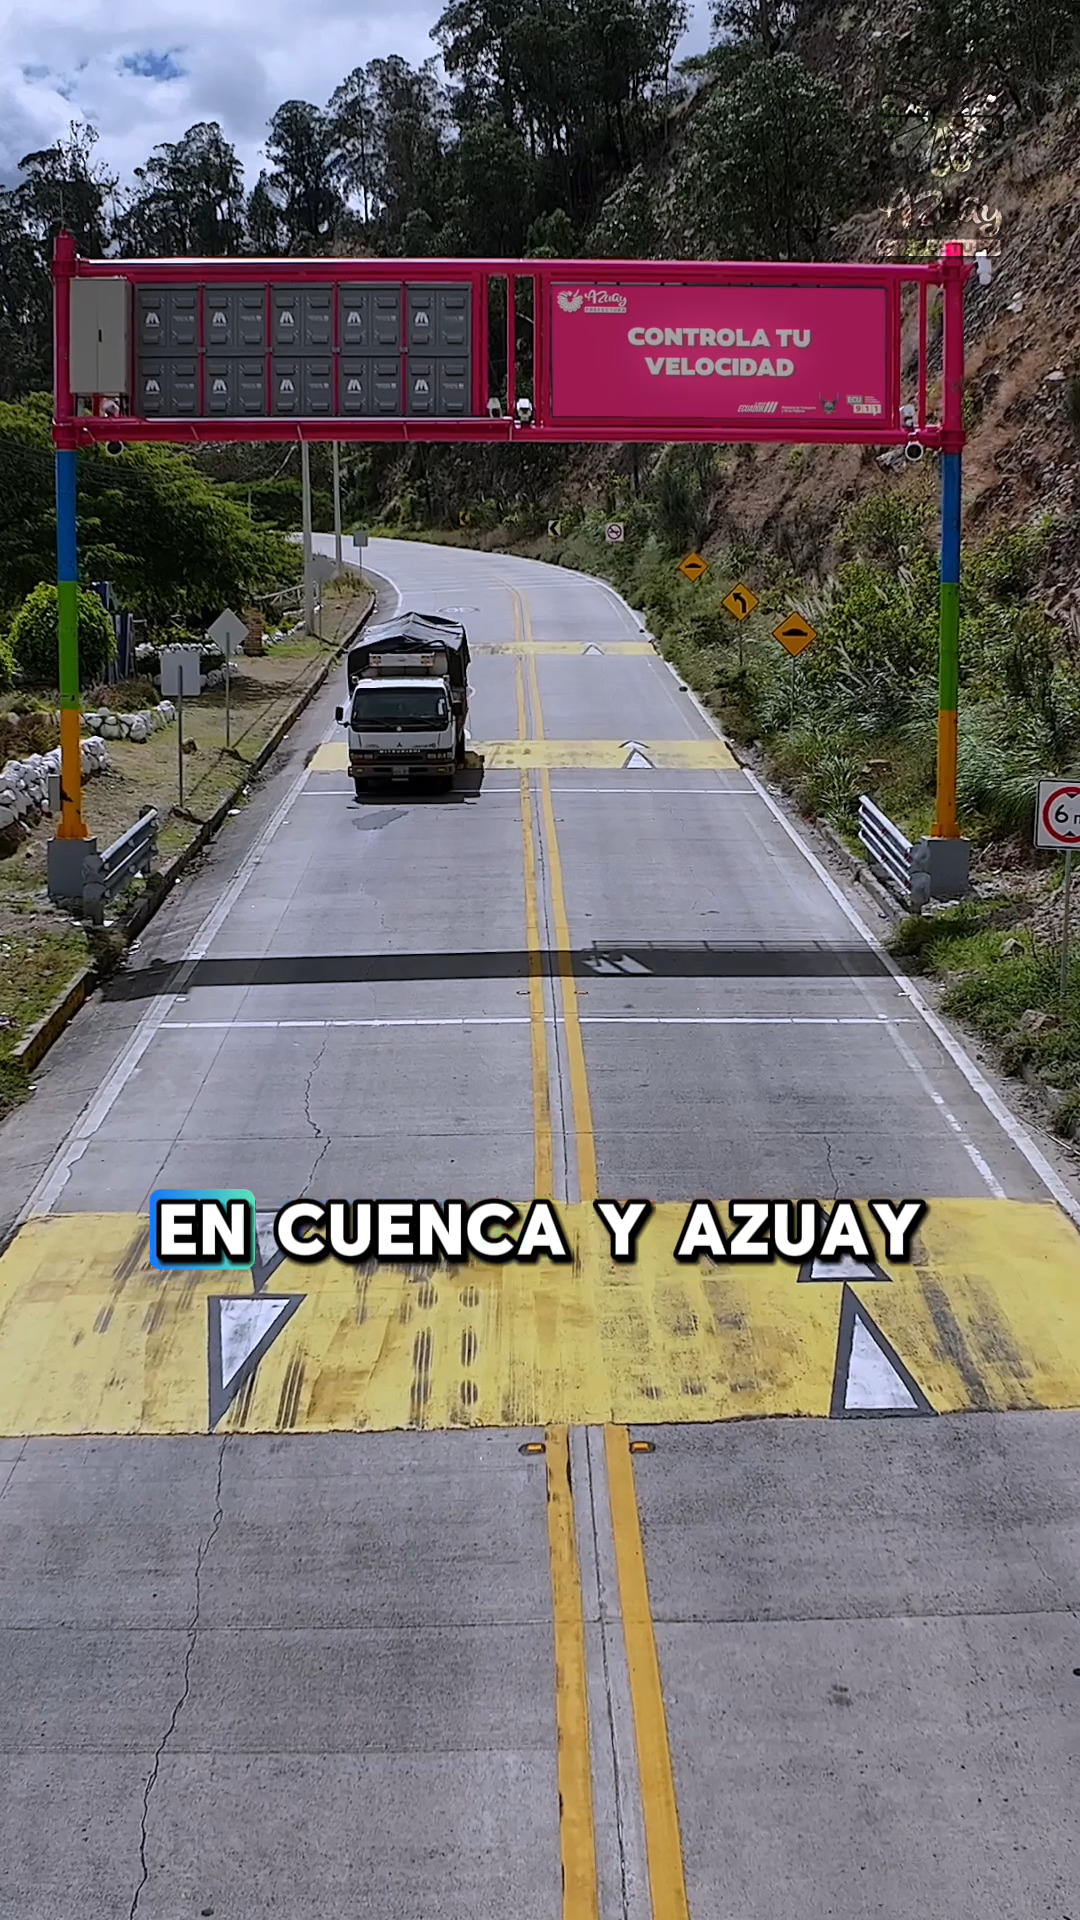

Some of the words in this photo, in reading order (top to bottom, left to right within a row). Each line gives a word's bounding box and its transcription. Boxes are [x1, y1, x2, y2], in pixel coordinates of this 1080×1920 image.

[627, 327, 771, 347] CONTROLA
[776, 328, 811, 348] TU
[644, 357, 795, 377] VELOCIDAD
[1054, 804, 1069, 824] 6
